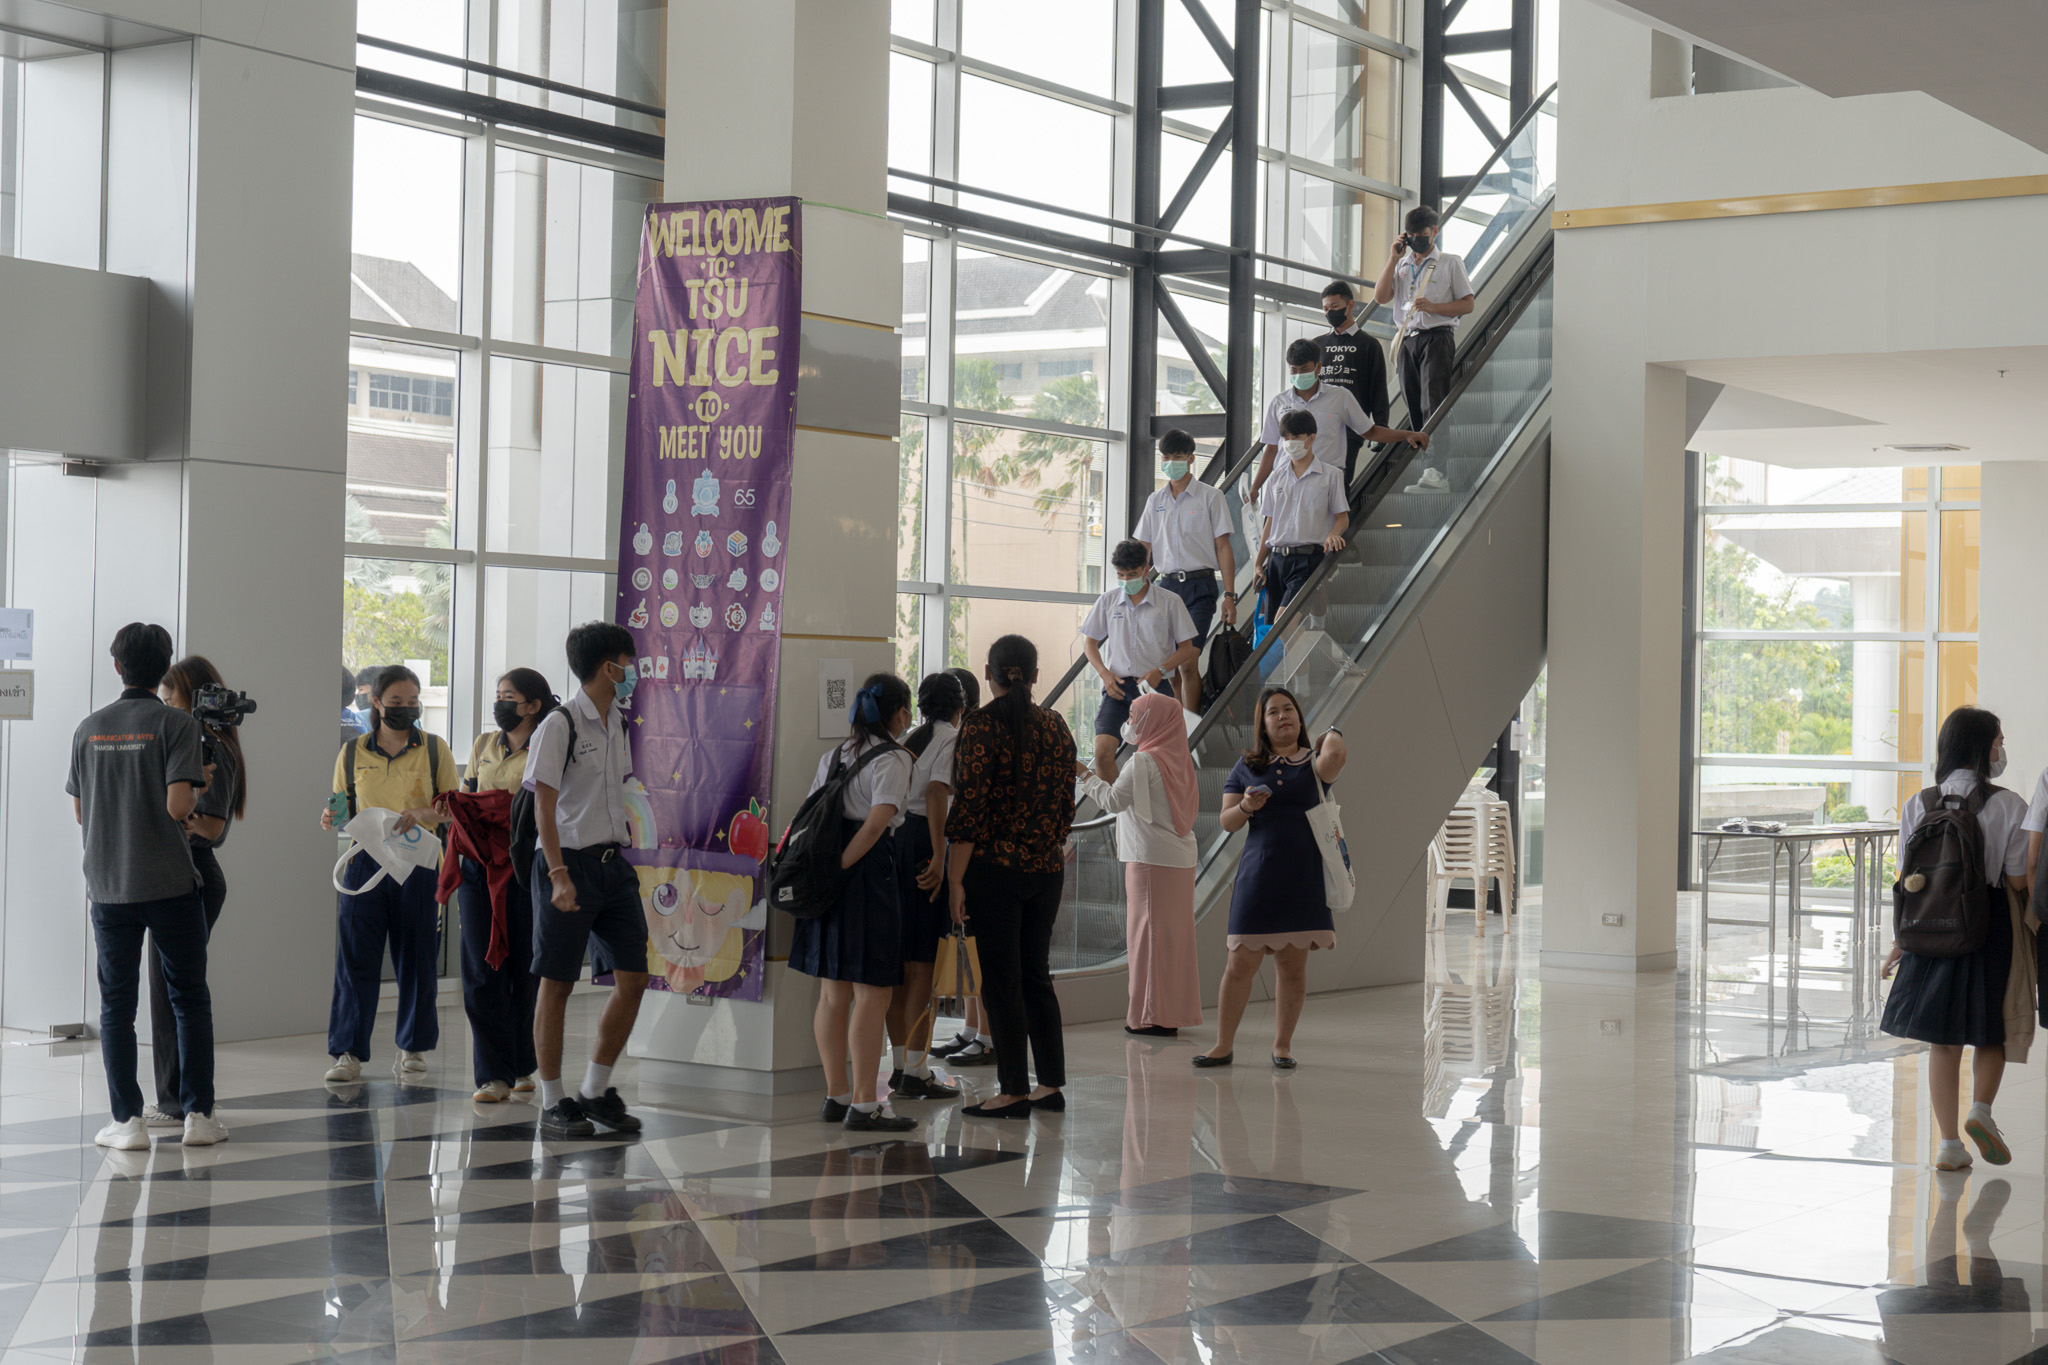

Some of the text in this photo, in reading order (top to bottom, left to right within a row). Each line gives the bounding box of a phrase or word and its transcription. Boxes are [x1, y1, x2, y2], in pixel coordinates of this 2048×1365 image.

[649, 205, 791, 257] WELCOME
[707, 257, 728, 277] TO
[686, 278, 748, 320] TSU
[648, 326, 780, 388] NICE
[1325, 345, 1357, 353] TOKYO
[1332, 354, 1345, 362] JO
[699, 398, 718, 416] TO
[659, 424, 762, 460] MEET YOU
[0, 685, 26, 697] งเข้า
[88, 733, 154, 742] COMMUNICATION ARTS
[116, 743, 146, 751] UNIVERSITY
